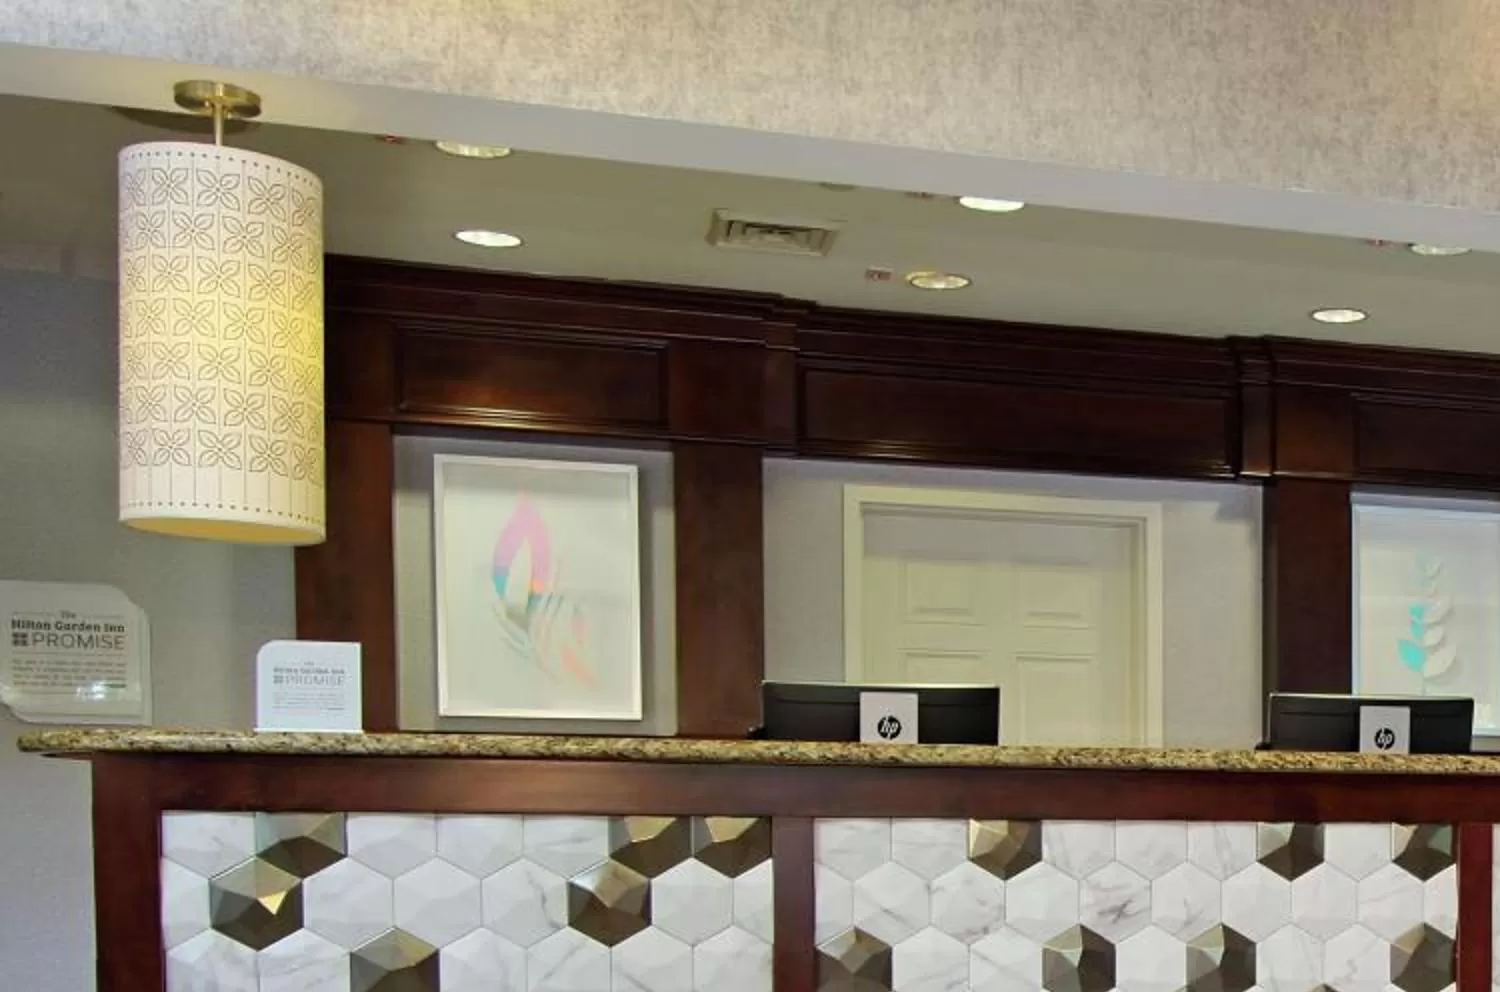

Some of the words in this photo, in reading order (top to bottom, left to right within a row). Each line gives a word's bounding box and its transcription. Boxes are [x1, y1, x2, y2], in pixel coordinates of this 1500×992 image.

[55, 621, 101, 633] Garden
[31, 632, 126, 650] PROMISE
[878, 715, 901, 740] hp
[1374, 728, 1395, 750] hp
